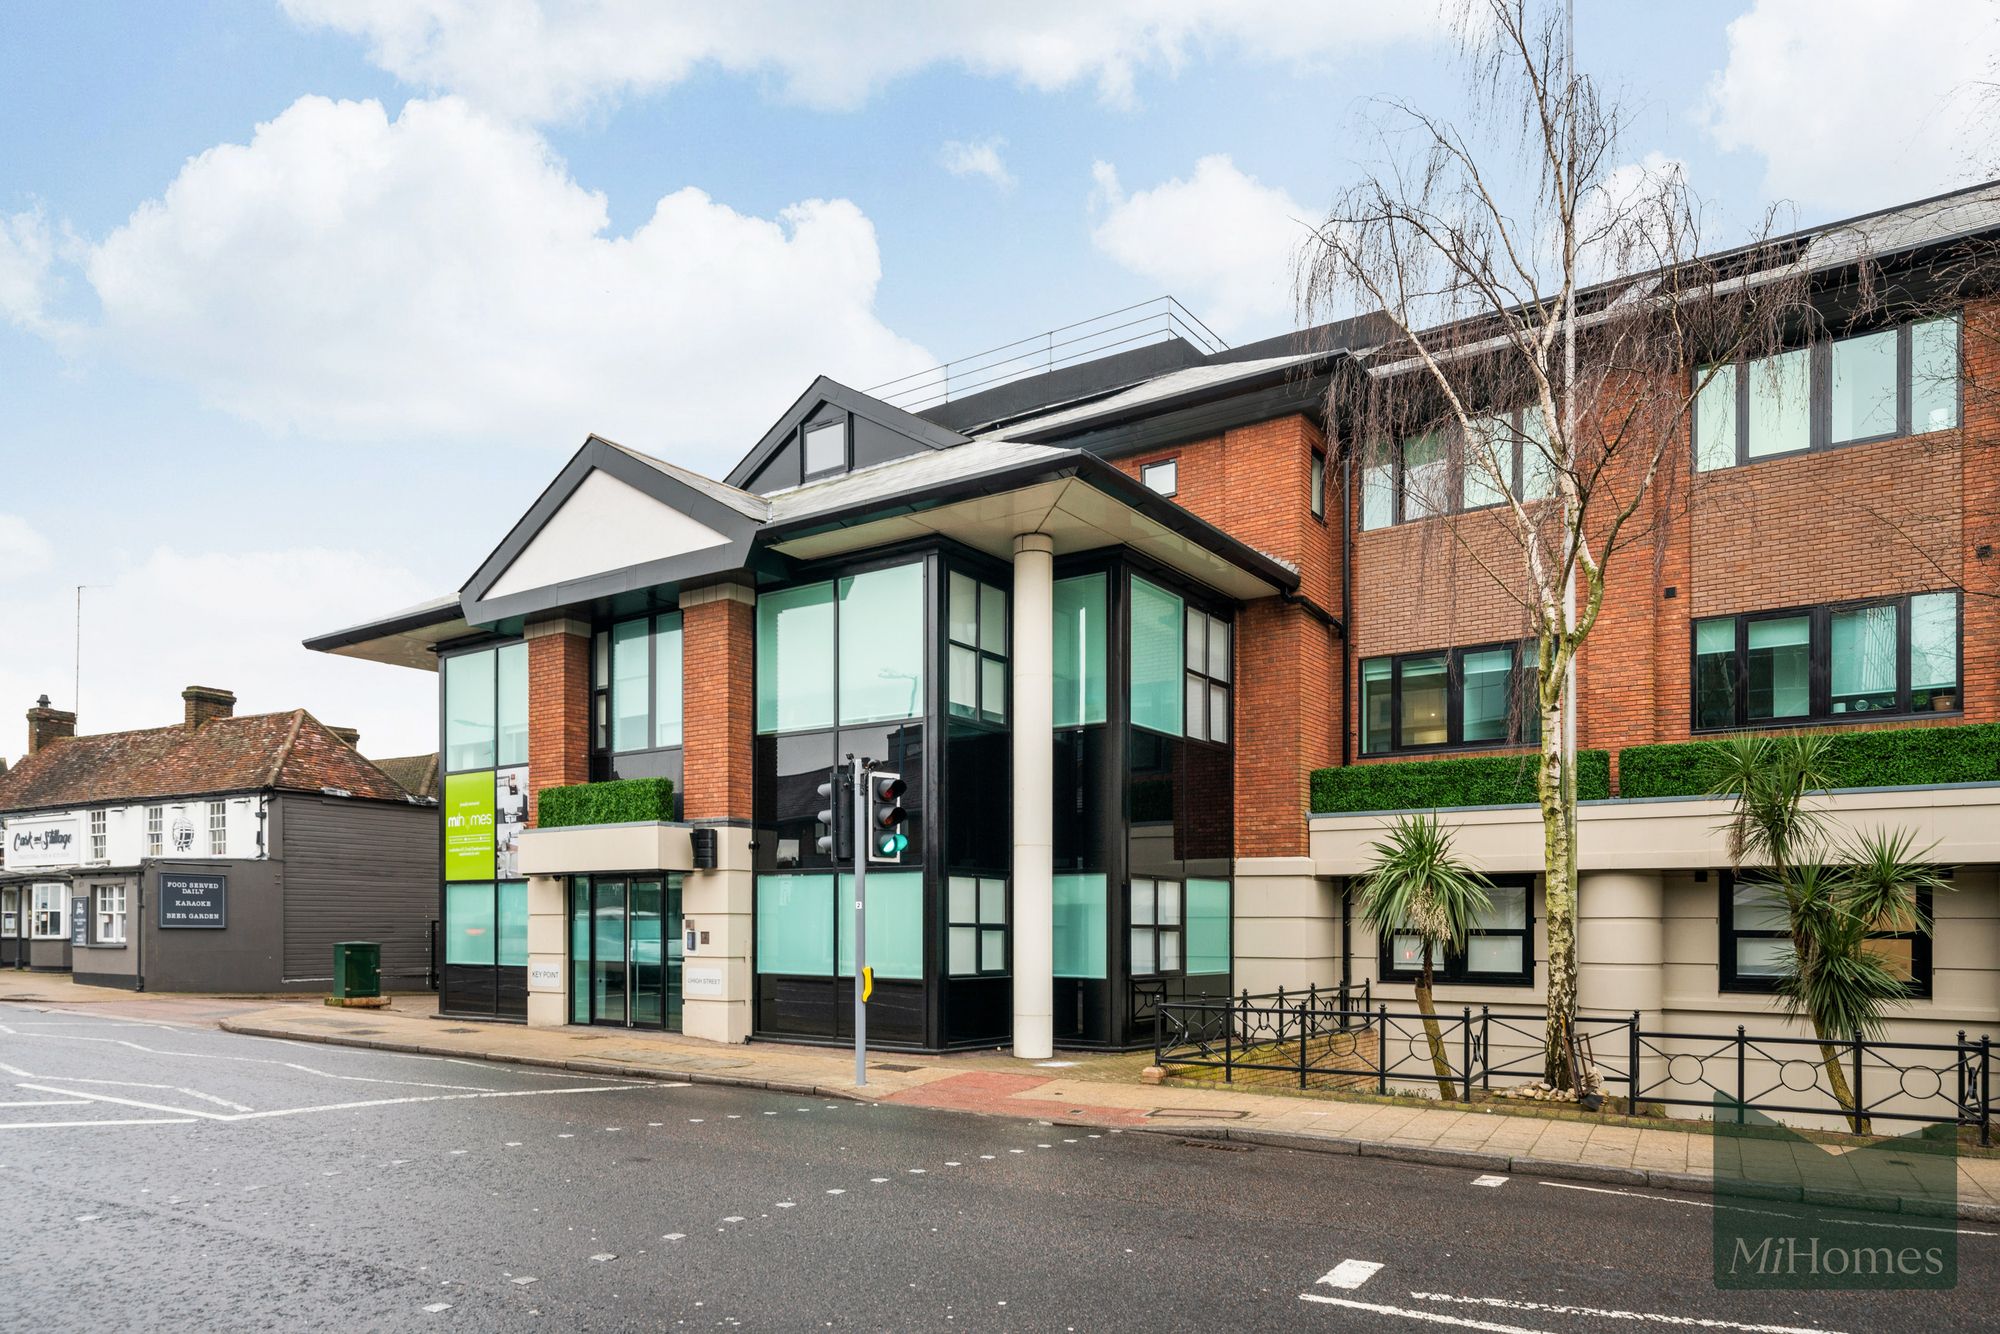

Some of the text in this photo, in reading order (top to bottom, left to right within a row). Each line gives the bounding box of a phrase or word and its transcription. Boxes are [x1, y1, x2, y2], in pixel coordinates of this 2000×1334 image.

[448, 812, 493, 828] mihmes
[14, 831, 34, 851] Cask
[42, 829, 71, 850] Stillage
[532, 970, 559, 978] KEY POINT
